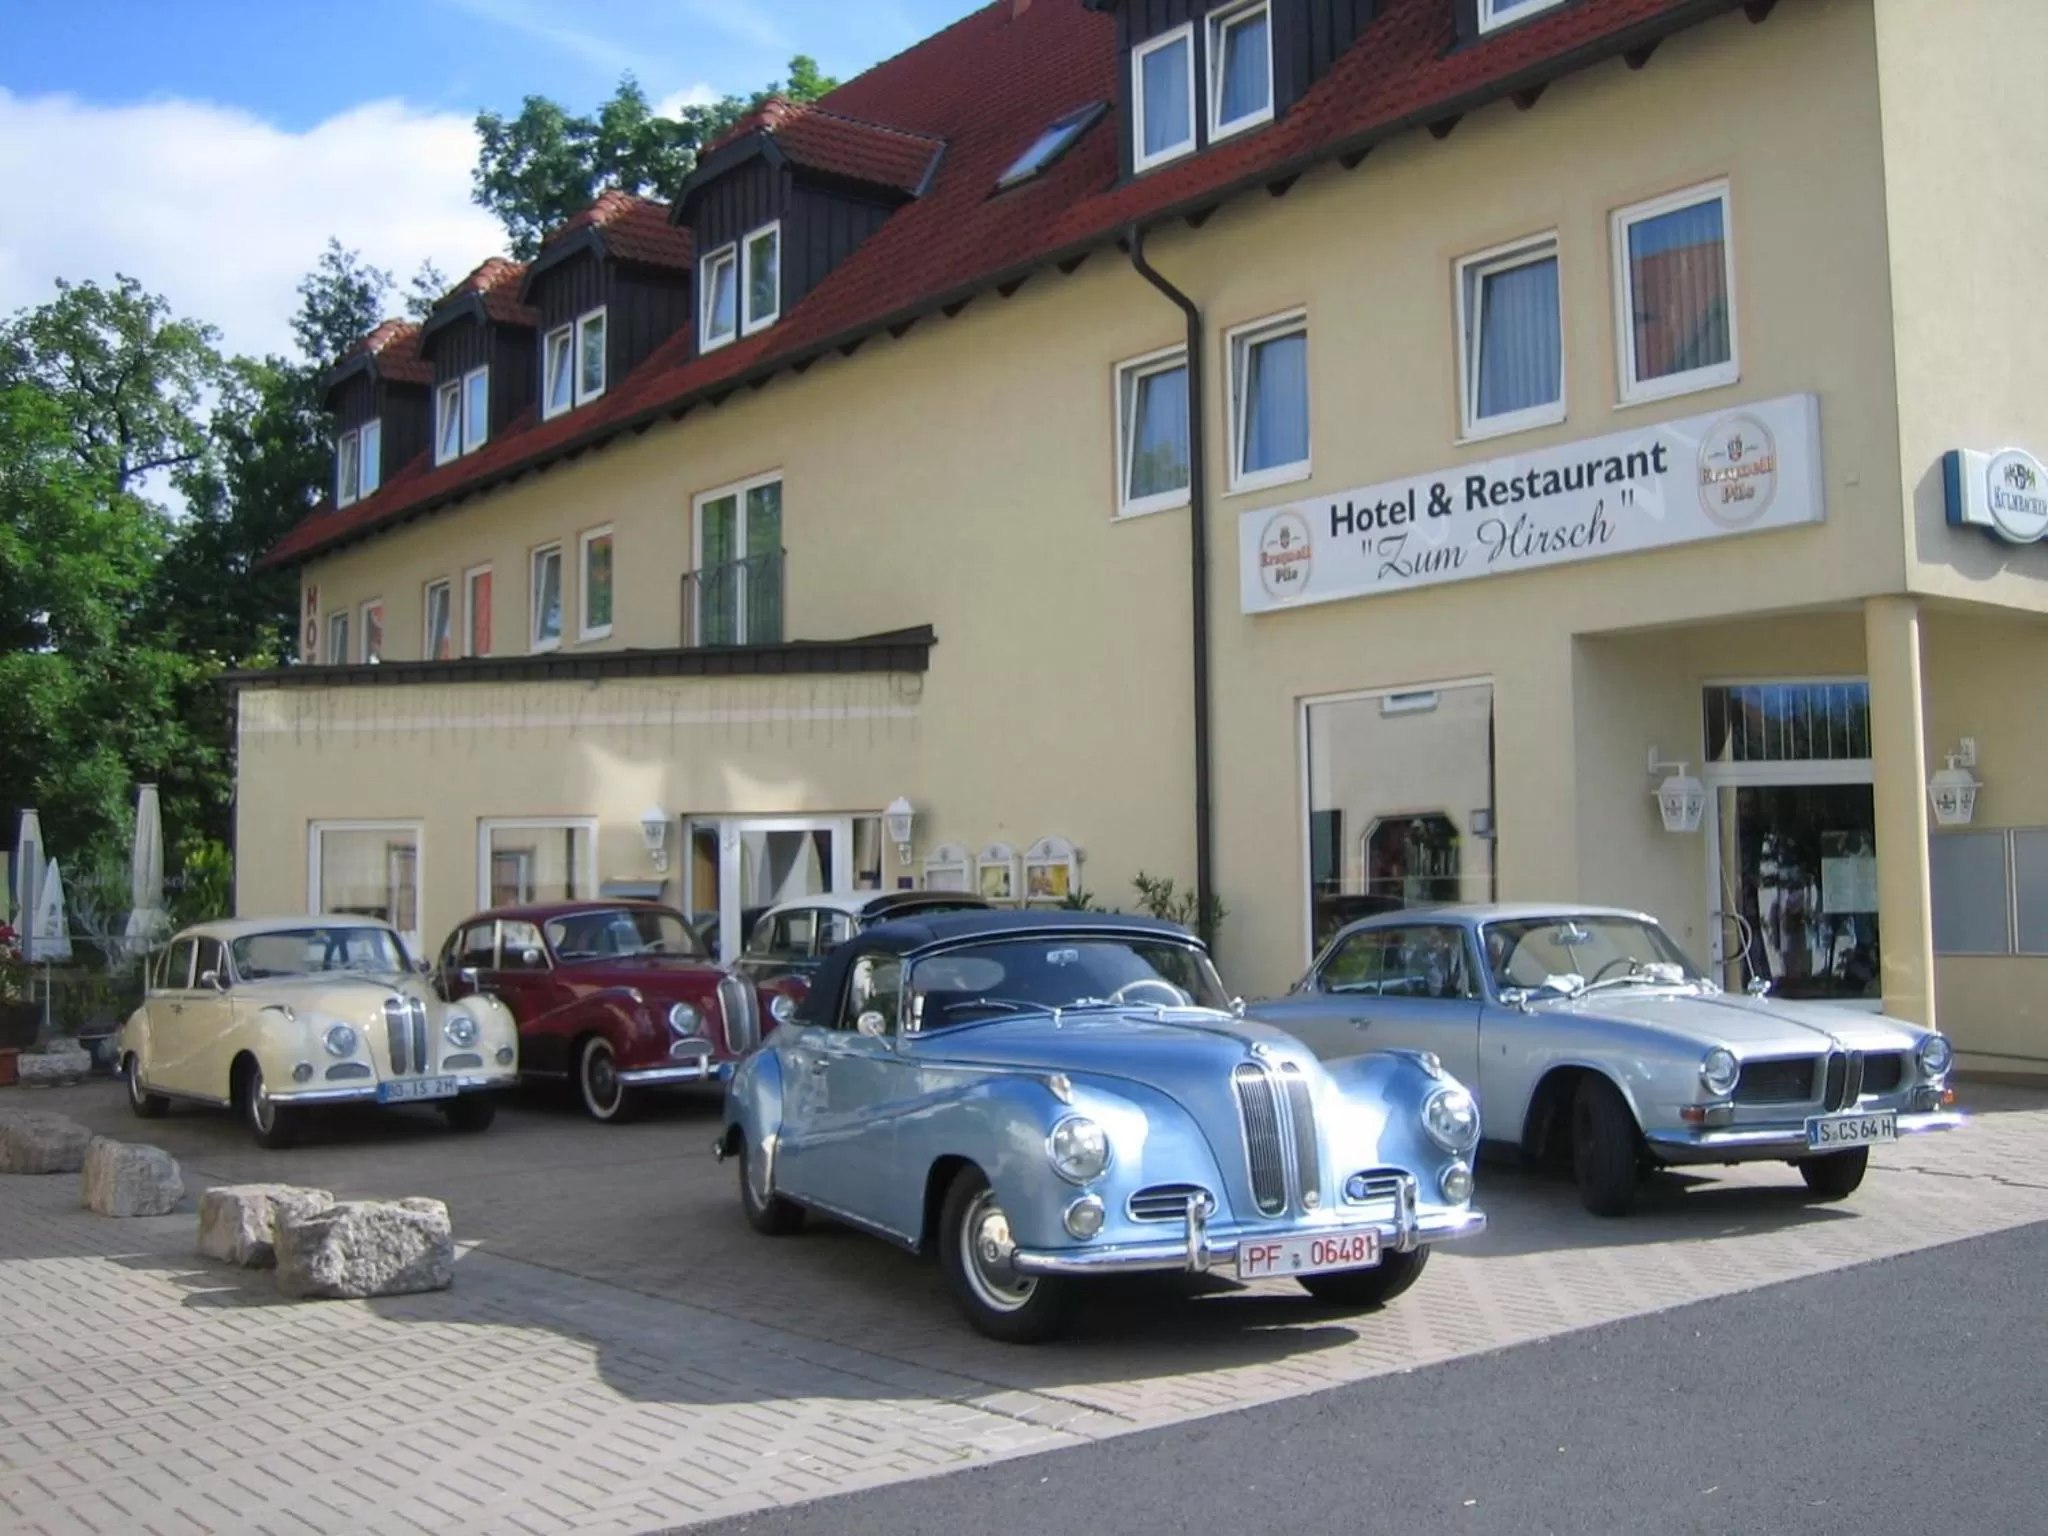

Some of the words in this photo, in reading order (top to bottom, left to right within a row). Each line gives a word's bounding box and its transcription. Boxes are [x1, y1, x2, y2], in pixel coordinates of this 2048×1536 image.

[1331, 488, 1415, 537] Hotel
[1427, 482, 1453, 518] &
[1465, 441, 1668, 512] Restaurant
[1249, 1244, 1282, 1273] PF
[1311, 1235, 1372, 1266] 06481
